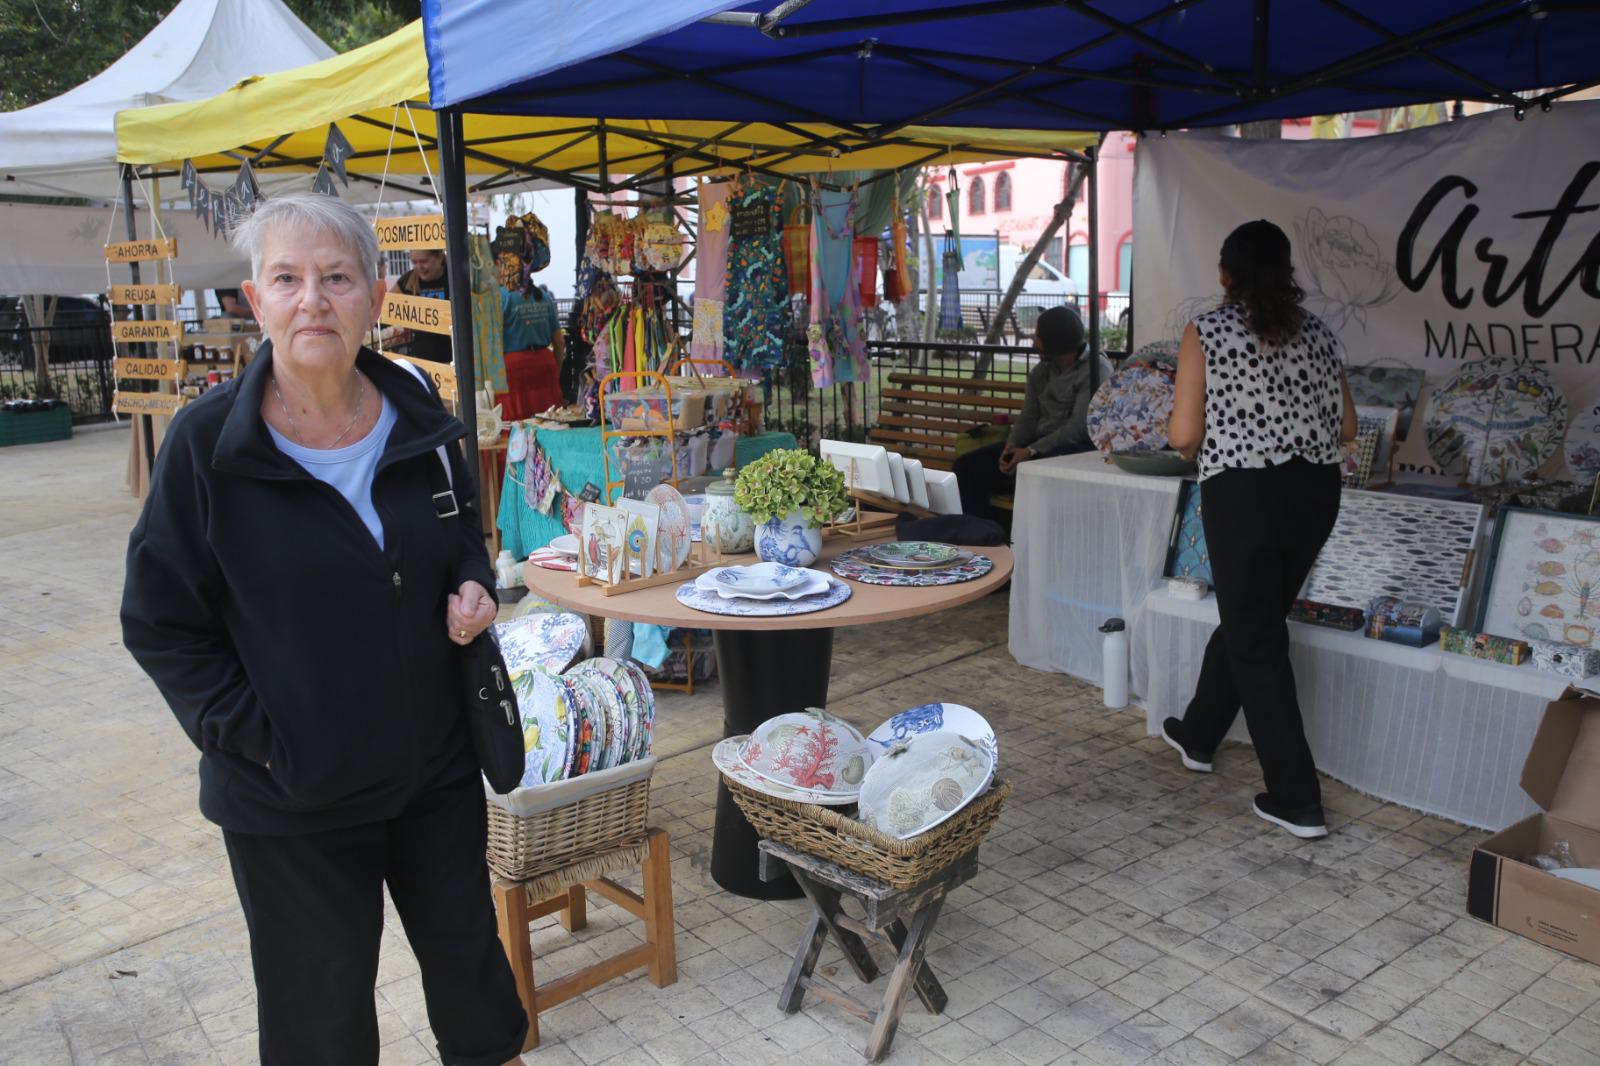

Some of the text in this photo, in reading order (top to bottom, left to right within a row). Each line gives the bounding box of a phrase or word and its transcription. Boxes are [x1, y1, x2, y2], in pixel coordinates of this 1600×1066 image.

[377, 223, 446, 244] COSMETICOS
[118, 244, 158, 257] AHORRA
[125, 288, 156, 301] REUSA
[388, 301, 439, 326] PAÑALES
[121, 326, 170, 338] GARANTIA
[126, 362, 167, 376] CALIDAD
